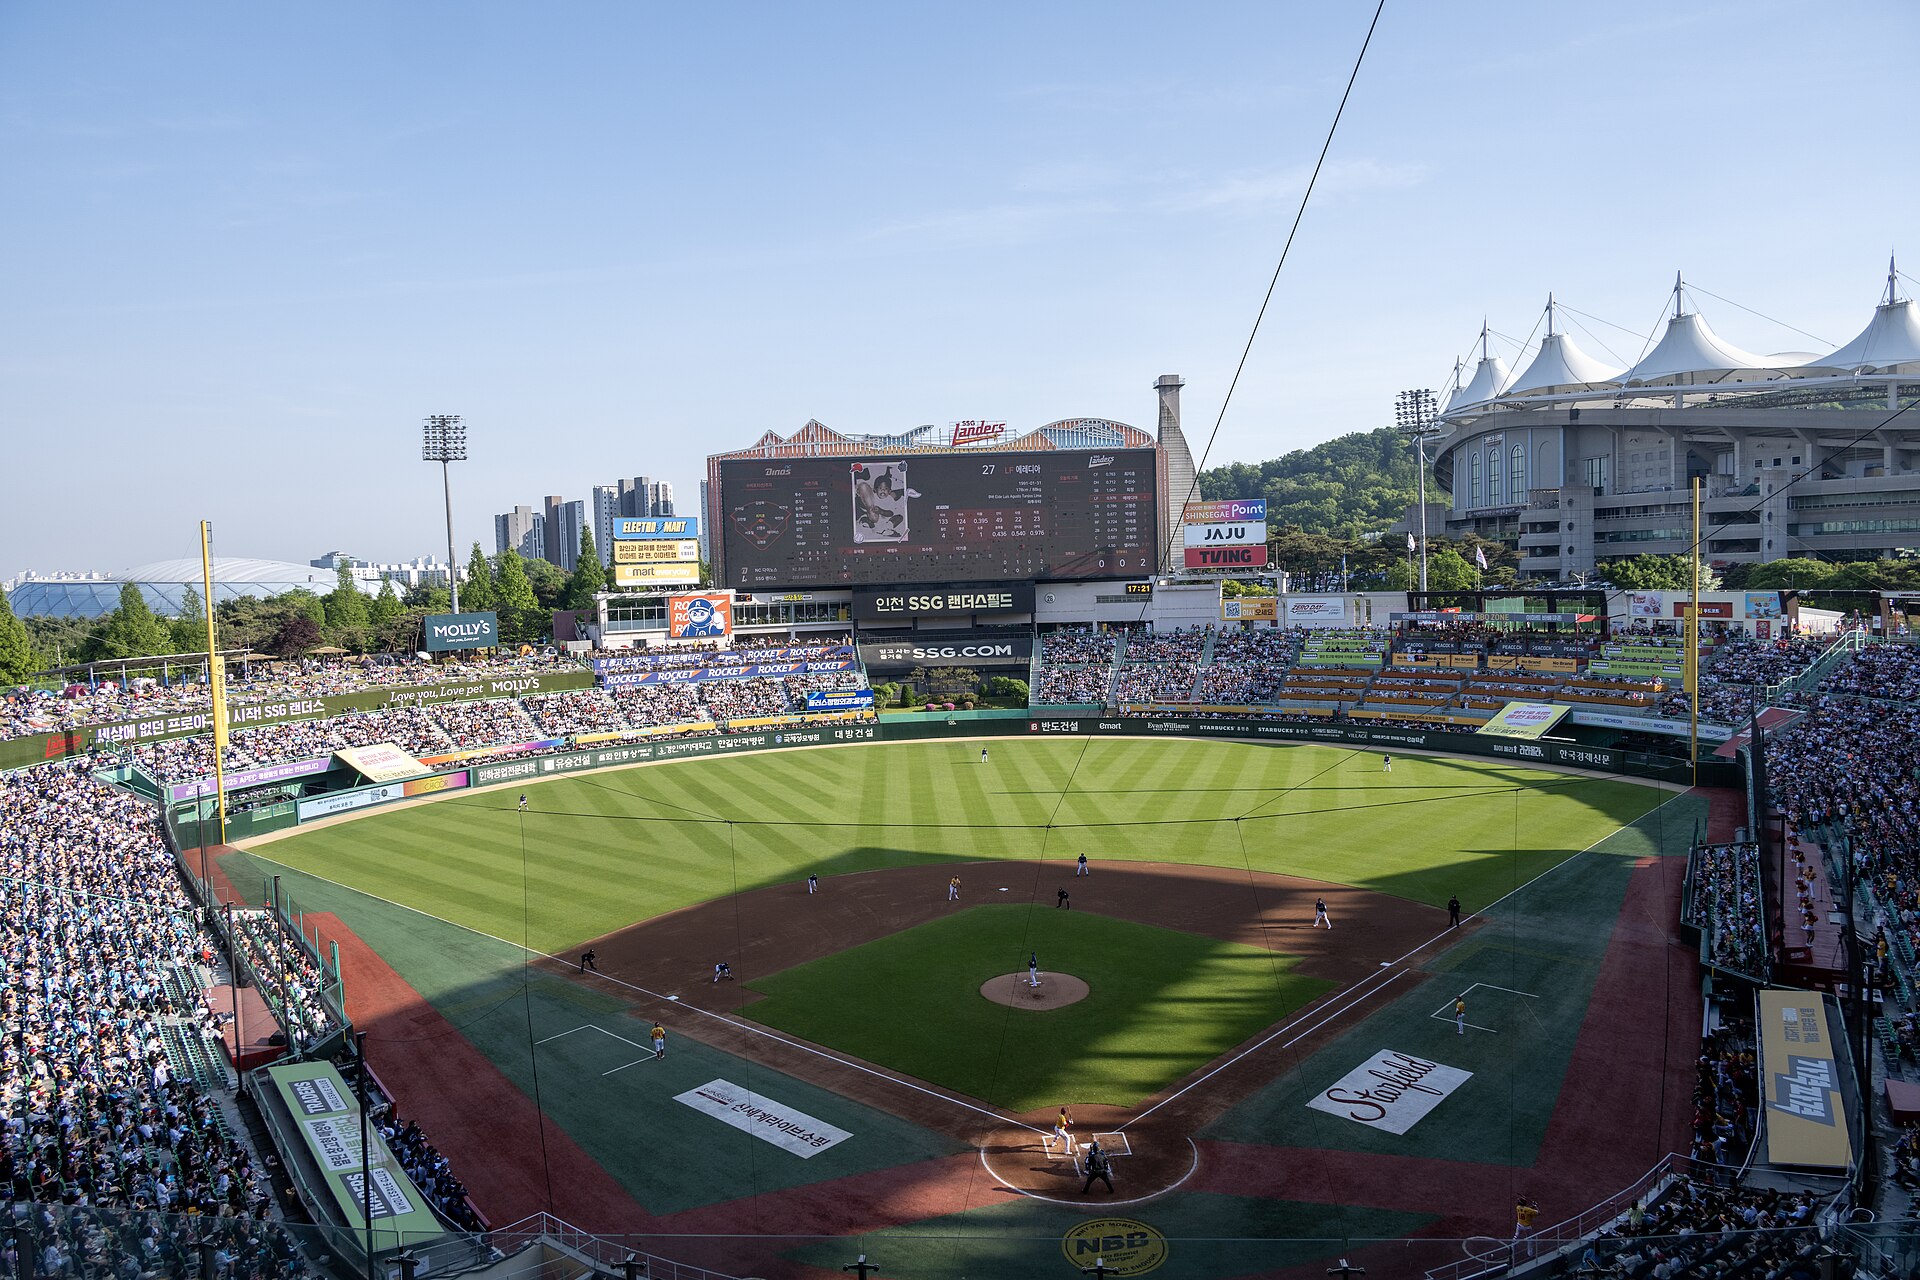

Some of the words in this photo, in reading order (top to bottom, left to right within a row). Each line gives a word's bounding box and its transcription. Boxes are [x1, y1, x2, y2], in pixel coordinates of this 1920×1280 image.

[952, 421, 1006, 446] Landers
[1088, 455, 1114, 468] Landers
[982, 464, 996, 474] 27
[1005, 466, 1014, 474] LF
[1016, 464, 1041, 474] 에레디아
[1186, 511, 1229, 519] SHINSEGAE
[1232, 504, 1263, 518] Point
[622, 522, 656, 533] ELECTRO
[664, 521, 687, 533] MART
[1204, 527, 1245, 540] JAJU
[1099, 560, 1105, 568] 0
[1120, 559, 1126, 567] 0
[1140, 558, 1146, 567] 2
[1199, 549, 1251, 564] TVING
[626, 567, 655, 576] emart
[876, 597, 904, 612] 인천
[909, 596, 943, 611] SSG
[948, 593, 1013, 610] 랜더스필드
[433, 620, 490, 637] MOLLY'S
[748, 649, 781, 658] ROCKET
[790, 648, 823, 657] ROCKET
[913, 645, 1012, 658] SSG.COM
[658, 654, 702, 664] 로케트배터리
[708, 667, 744, 677] ROCKET
[758, 664, 794, 673] ROCKET
[807, 662, 842, 670] ROCKET
[607, 674, 644, 684] ROCKET
[658, 671, 694, 681] ROCKET
[390, 691, 414, 702] Love
[416, 690, 438, 700] you,
[440, 686, 465, 696] Love
[466, 685, 484, 696] pet
[492, 677, 540, 693] MOLLY'S
[96, 724, 136, 743] 세상에
[140, 720, 164, 737] 없던
[234, 706, 262, 722] 시작!
[265, 704, 286, 718] SSG
[290, 700, 325, 715] 랜더스
[1042, 721, 1078, 731] 반도건설
[784, 735, 819, 743] 국제성모병원
[835, 728, 873, 739] 대방건설
[666, 742, 712, 754] 경인여자대학교
[718, 736, 765, 749] 한길안과병원
[556, 755, 590, 769] 유승건설
[1560, 749, 1610, 765] 한국경제신문
[479, 762, 536, 781] 인하공업전문대학
[240, 776, 257, 785] APEC
[424, 780, 448, 791] CHICOR
[1326, 1053, 1444, 1121] Starfield
[294, 1082, 326, 1113] TRADERS
[310, 1120, 331, 1136] 매장에
[731, 1103, 831, 1148] 신세계라이브쇼핑
[320, 1136, 344, 1154] 창고형
[330, 1153, 351, 1166] 열린
[1075, 1227, 1089, 1237] WHY
[1076, 1232, 1149, 1255] NBB
